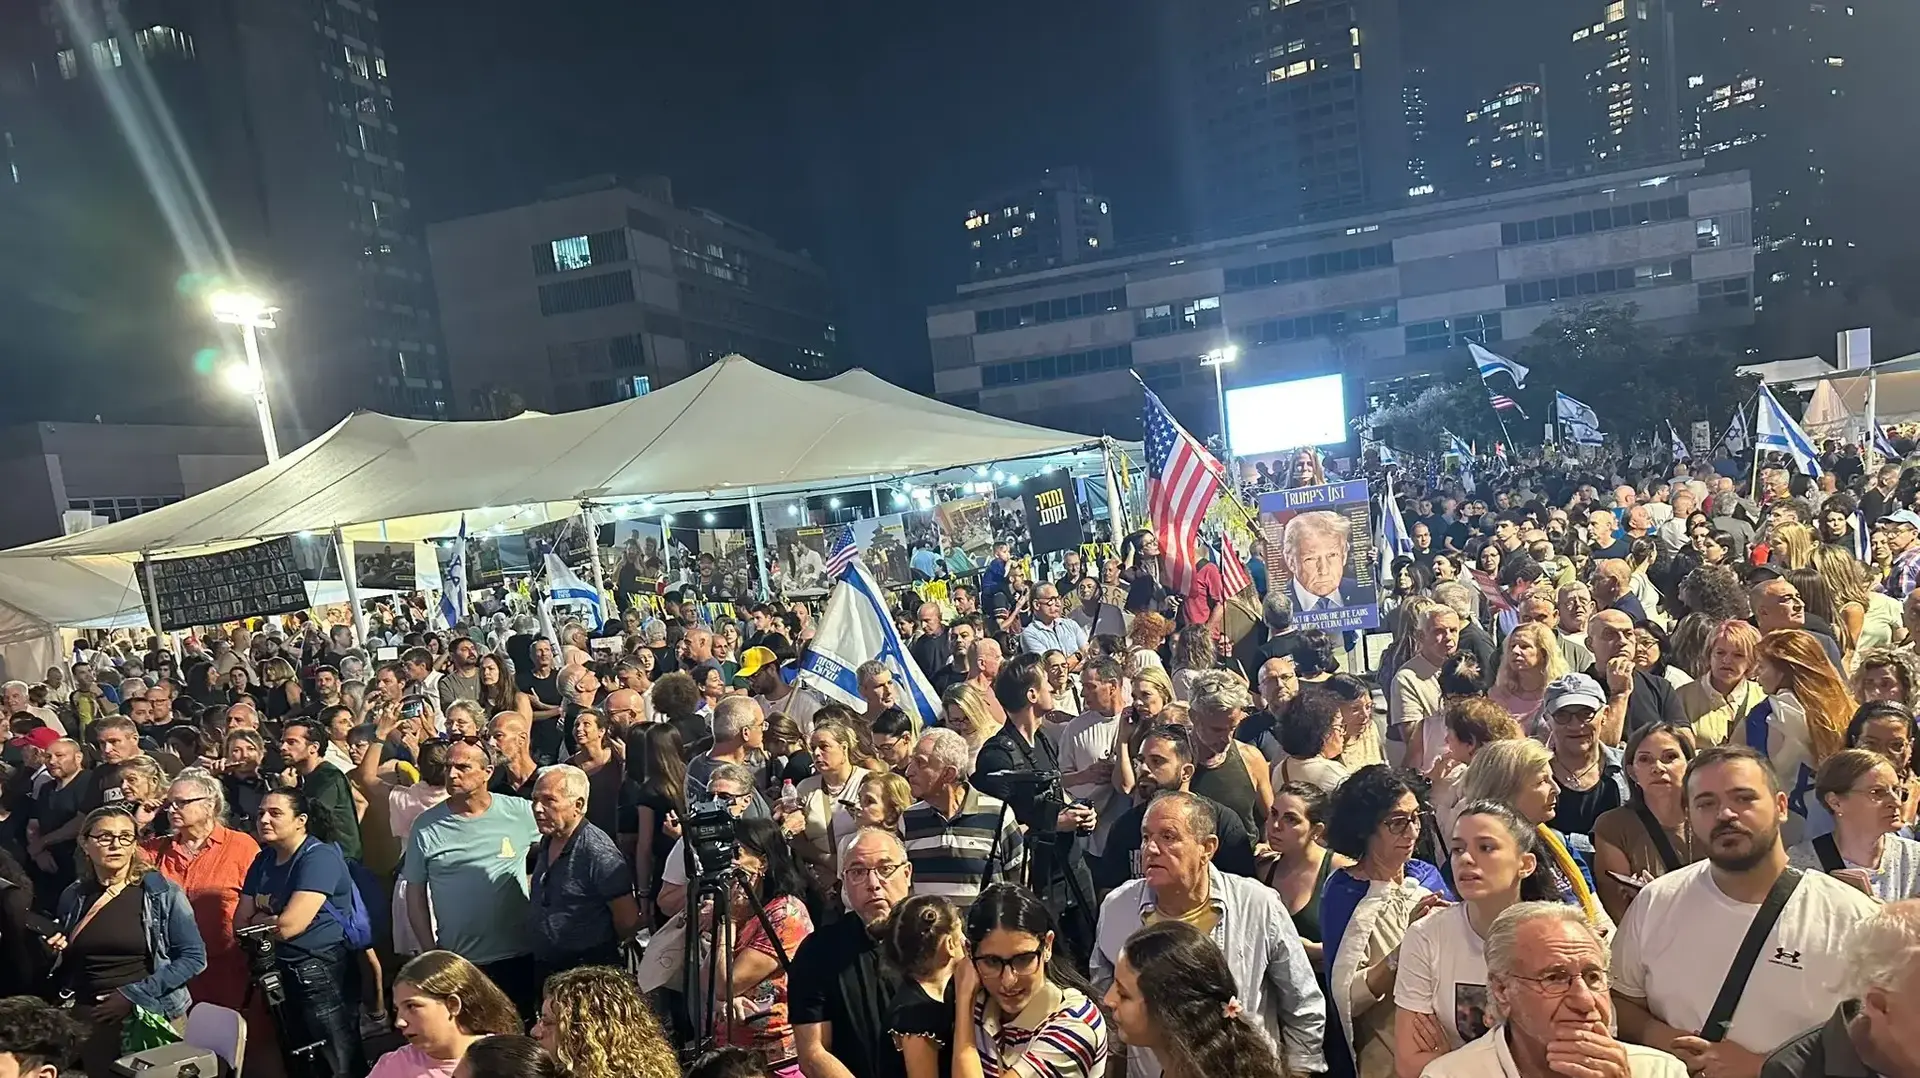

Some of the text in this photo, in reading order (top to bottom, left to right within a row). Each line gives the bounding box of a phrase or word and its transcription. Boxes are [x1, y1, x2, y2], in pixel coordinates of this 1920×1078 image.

[1035, 488, 1064, 511] נחזיר.
[1282, 486, 1345, 508] TRUMP'S LIST
[1039, 504, 1068, 526] נקום.
[1352, 608, 1368, 617] EARNS
